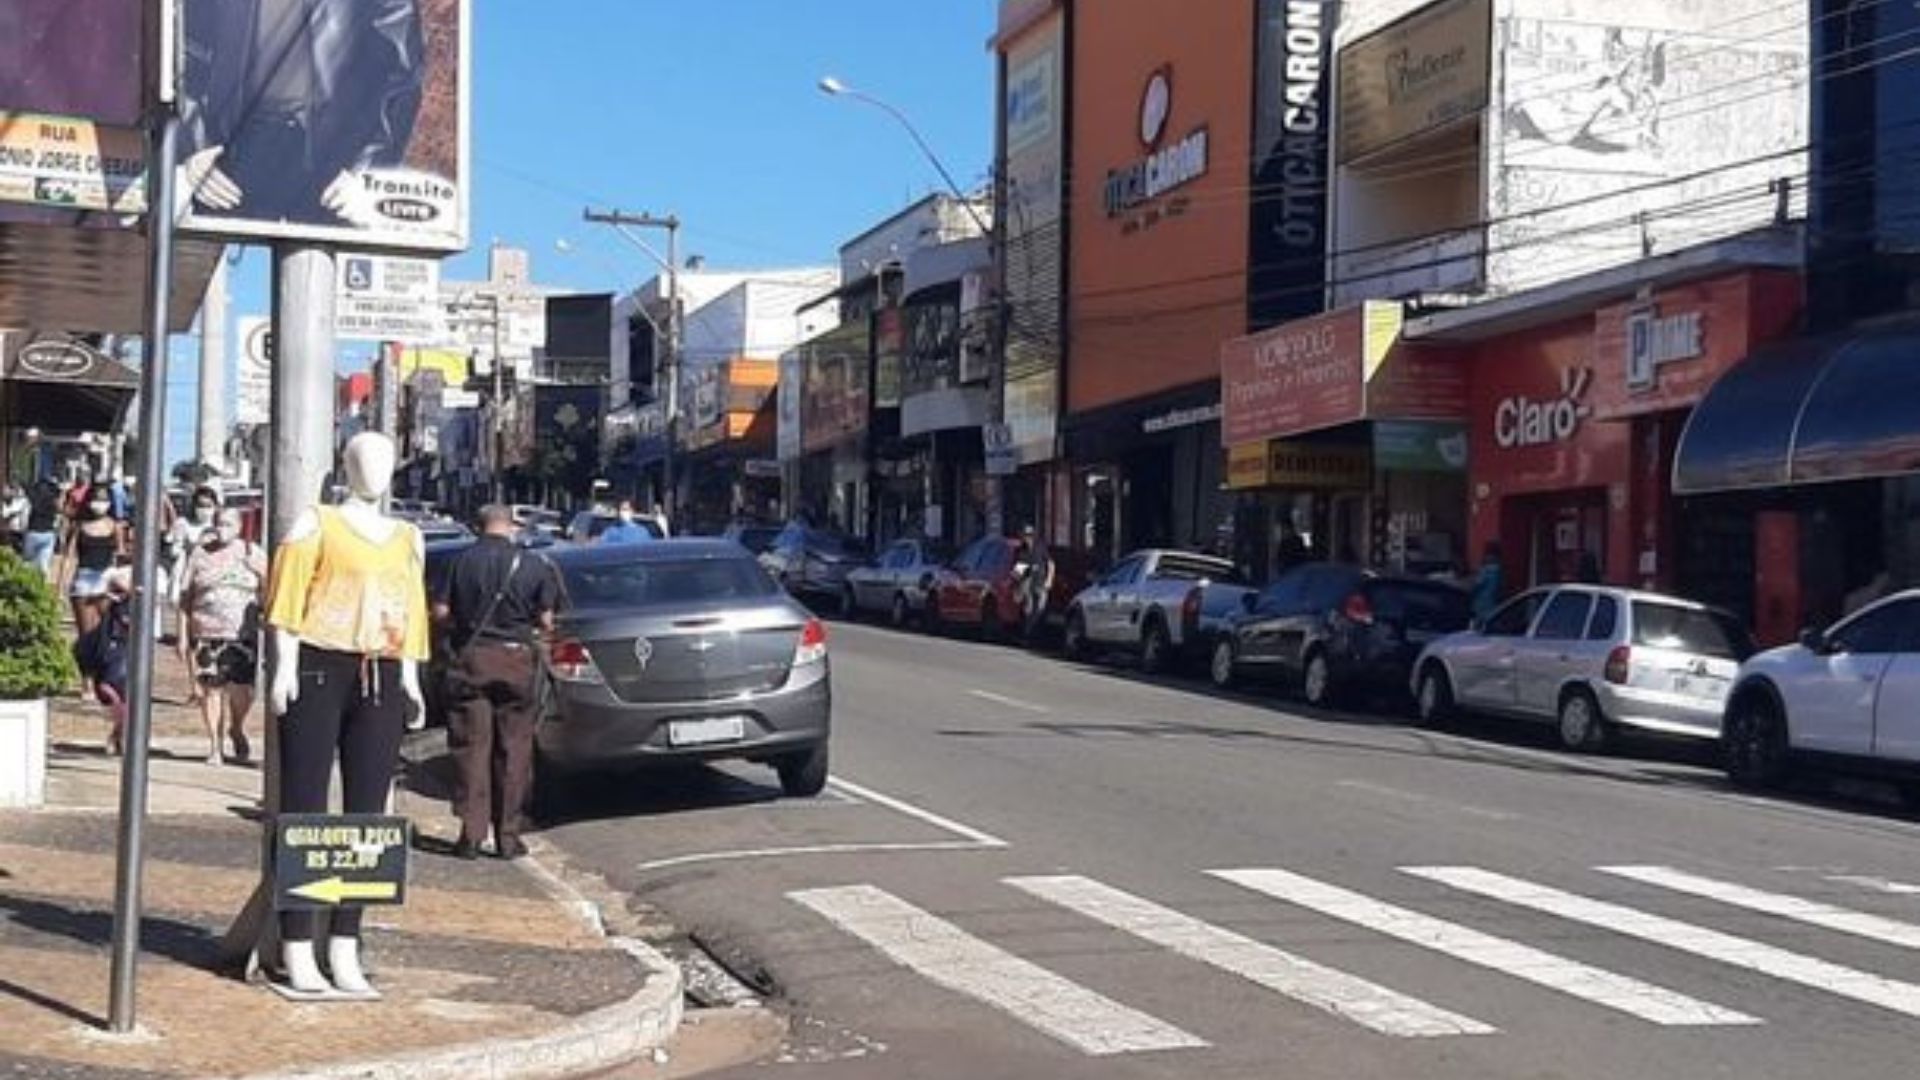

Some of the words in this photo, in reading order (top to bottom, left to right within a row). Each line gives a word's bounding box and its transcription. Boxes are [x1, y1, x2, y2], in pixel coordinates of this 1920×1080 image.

[39, 123, 77, 141] RUA
[37, 150, 81, 172] JORGE
[1494, 396, 1576, 446] Claro
